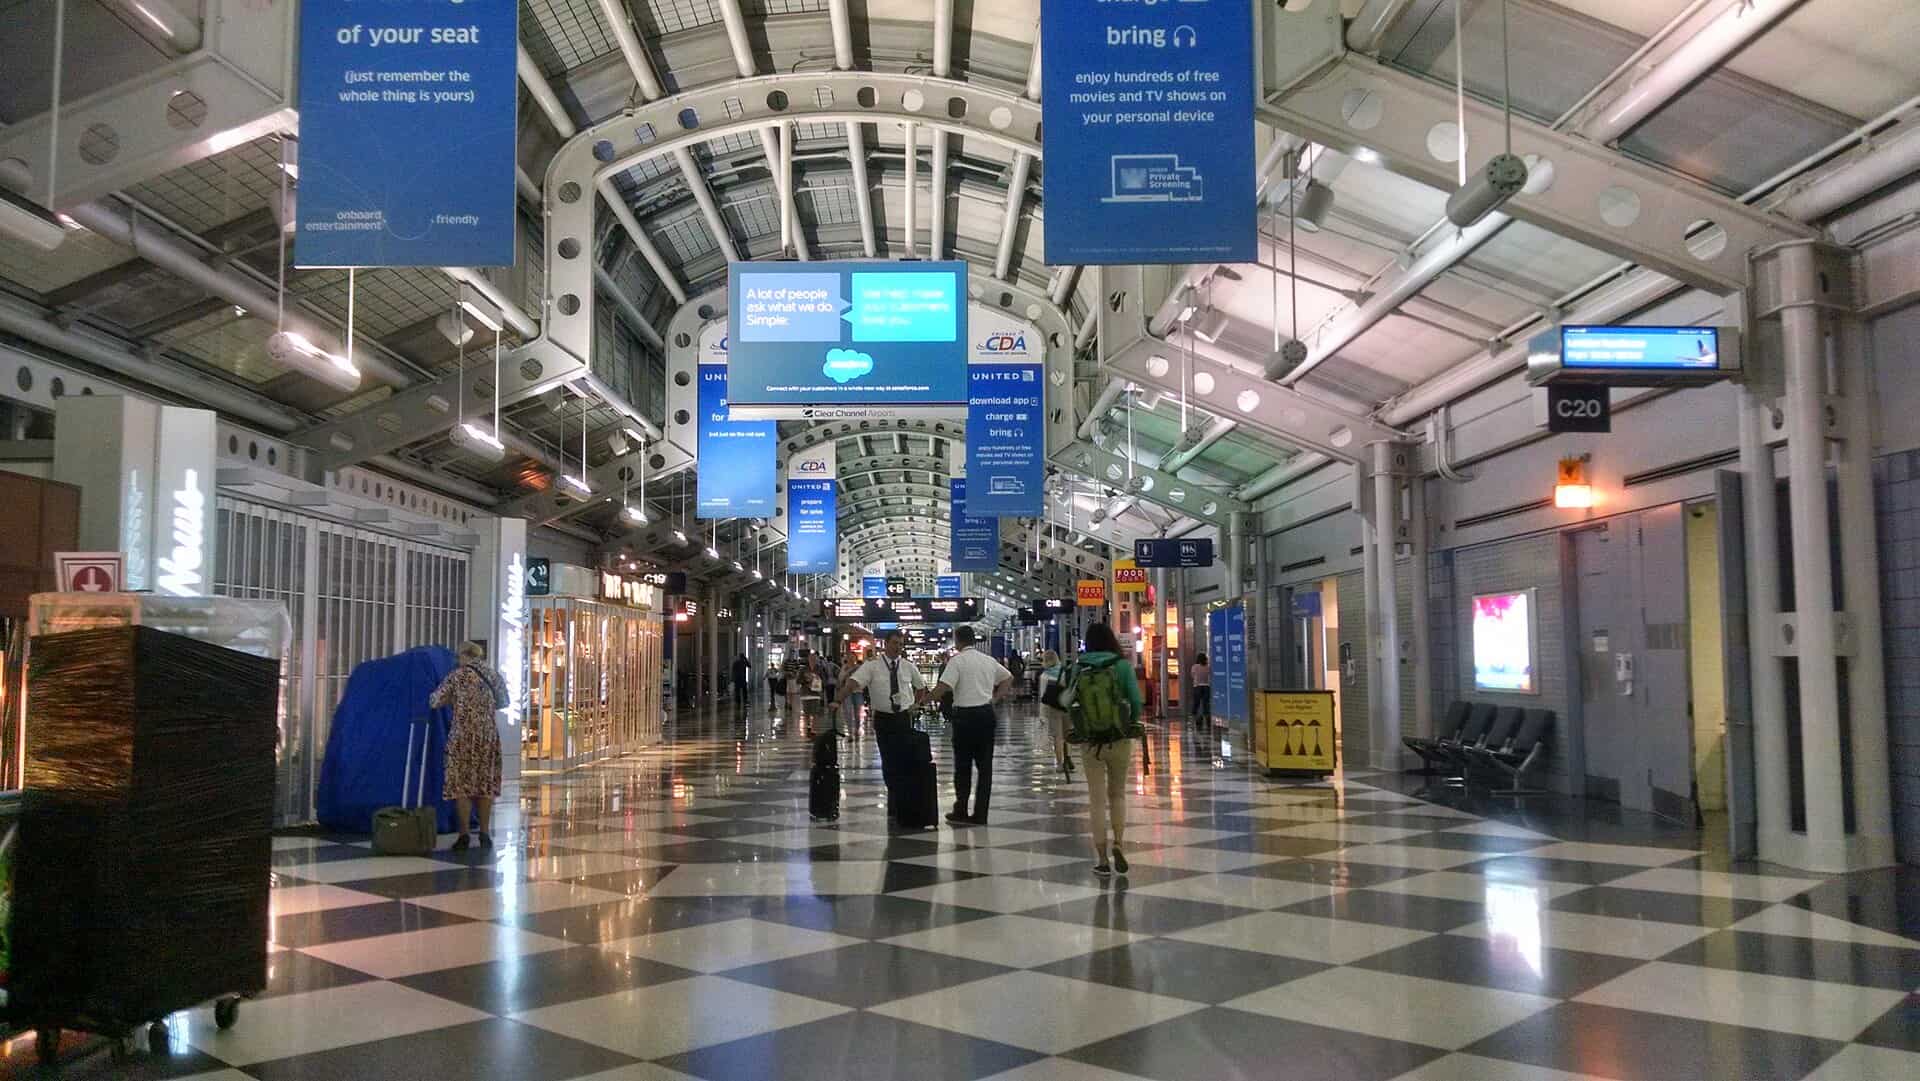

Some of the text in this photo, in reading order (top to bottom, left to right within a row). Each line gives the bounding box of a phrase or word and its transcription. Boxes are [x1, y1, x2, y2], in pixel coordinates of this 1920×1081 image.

[337, 24, 480, 47] of your seat
[1106, 25, 1166, 47] bring
[345, 70, 470, 84] (just remember the
[1075, 70, 1220, 85] enjoy hundreds of free
[339, 90, 475, 104] whole thing is yours)
[1070, 90, 1227, 104] movies and TV shows on
[1082, 109, 1215, 125] your personal device
[1149, 173, 1180, 181] Private
[1149, 181, 1191, 190] Screening
[336, 211, 382, 221] onboard
[436, 214, 480, 226] friendly
[305, 221, 383, 231] entertainment
[746, 288, 828, 302] A lot of people
[746, 301, 766, 313] ask
[768, 301, 797, 313] what
[798, 303, 815, 313] we
[985, 336, 1027, 351] CDA
[972, 372, 1020, 381] UNITED
[969, 396, 1030, 407] download app
[814, 409, 834, 417] Clear
[835, 409, 867, 417] Channel
[1556, 399, 1601, 417] C20
[711, 413, 724, 422] for
[985, 412, 1014, 422] charge
[989, 428, 1013, 438] bring
[800, 461, 826, 471] CDA
[1117, 569, 1143, 577] FOOD
[896, 584, 904, 594] B
